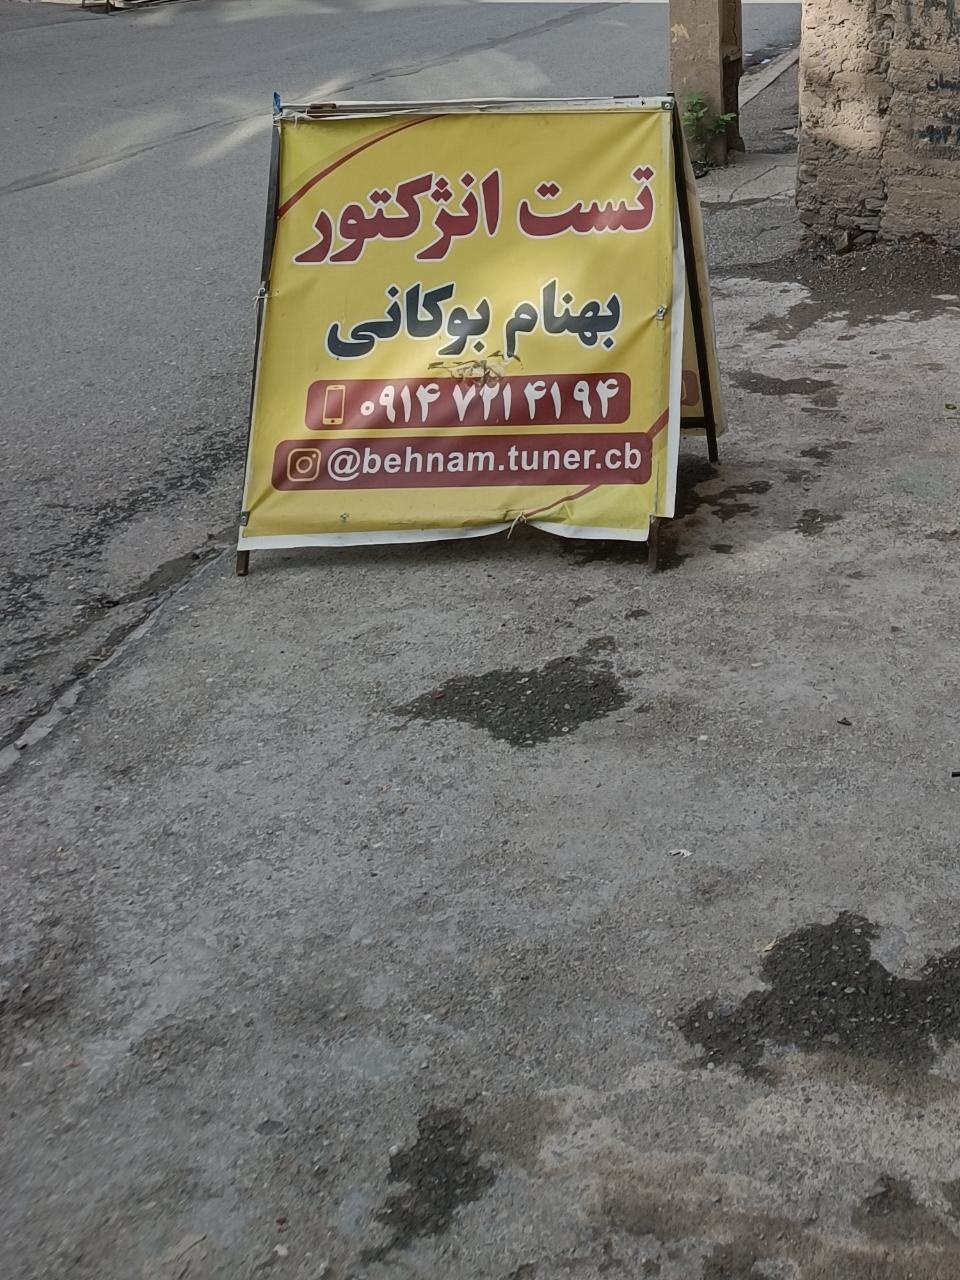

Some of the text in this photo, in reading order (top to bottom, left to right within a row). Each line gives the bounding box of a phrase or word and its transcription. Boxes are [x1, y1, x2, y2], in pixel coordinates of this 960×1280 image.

[292, 164, 657, 265] تست انژکتور
[325, 278, 622, 360] بهنام بوکانی
[359, 383, 442, 424] ۰۹۱۴
[452, 383, 512, 422] ۷۲۱
[326, 442, 643, 483] @behnam.tuner.cb
